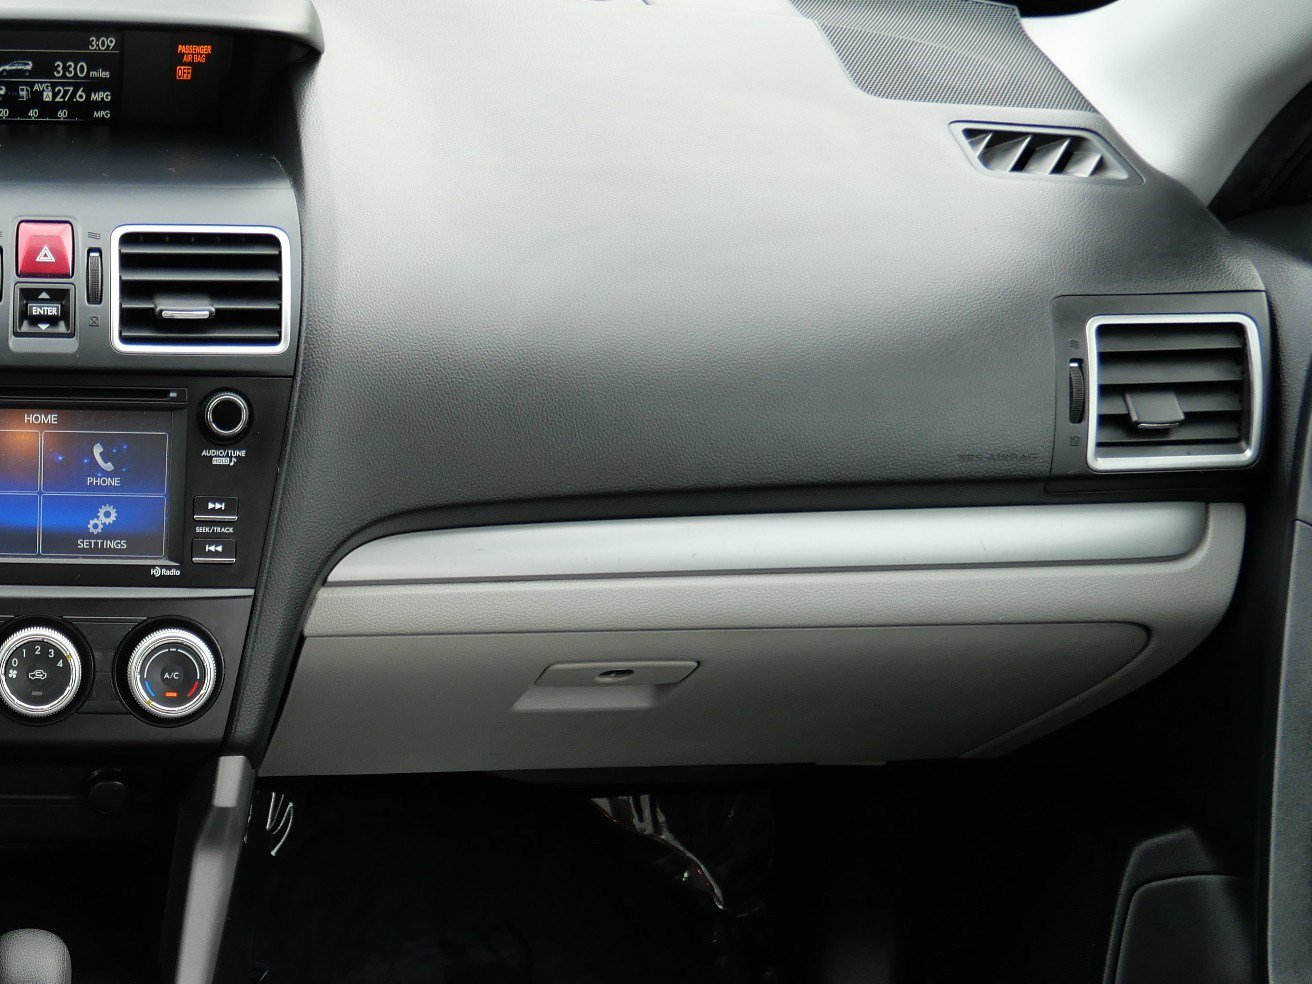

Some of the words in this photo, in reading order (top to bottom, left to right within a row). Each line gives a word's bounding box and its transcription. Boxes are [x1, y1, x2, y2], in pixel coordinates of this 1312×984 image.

[89, 37, 116, 50] 3:09
[178, 45, 212, 54] PASSENGER
[183, 54, 193, 62] AIR
[194, 54, 206, 62] BAG
[54, 61, 87, 77] 330
[90, 68, 110, 78] miles
[177, 66, 191, 79] OFF
[54, 86, 86, 102] 27.6
[90, 92, 111, 101] MPG
[0, 108, 9, 117] 20
[28, 109, 39, 118] 40
[57, 109, 68, 118] 60
[93, 110, 111, 118] MPG
[32, 306, 58, 315] ENTER
[24, 414, 58, 424] HOME
[201, 449, 246, 457] AUDIO/TUNE
[87, 477, 121, 487] PHONE
[77, 539, 127, 549] SETTINGS
[11, 657, 19, 667] 0
[22, 649, 26, 658] 1
[34, 645, 41, 655] 2
[48, 649, 55, 658] 3
[56, 659, 63, 667] 4
[163, 672, 179, 680] A/C
